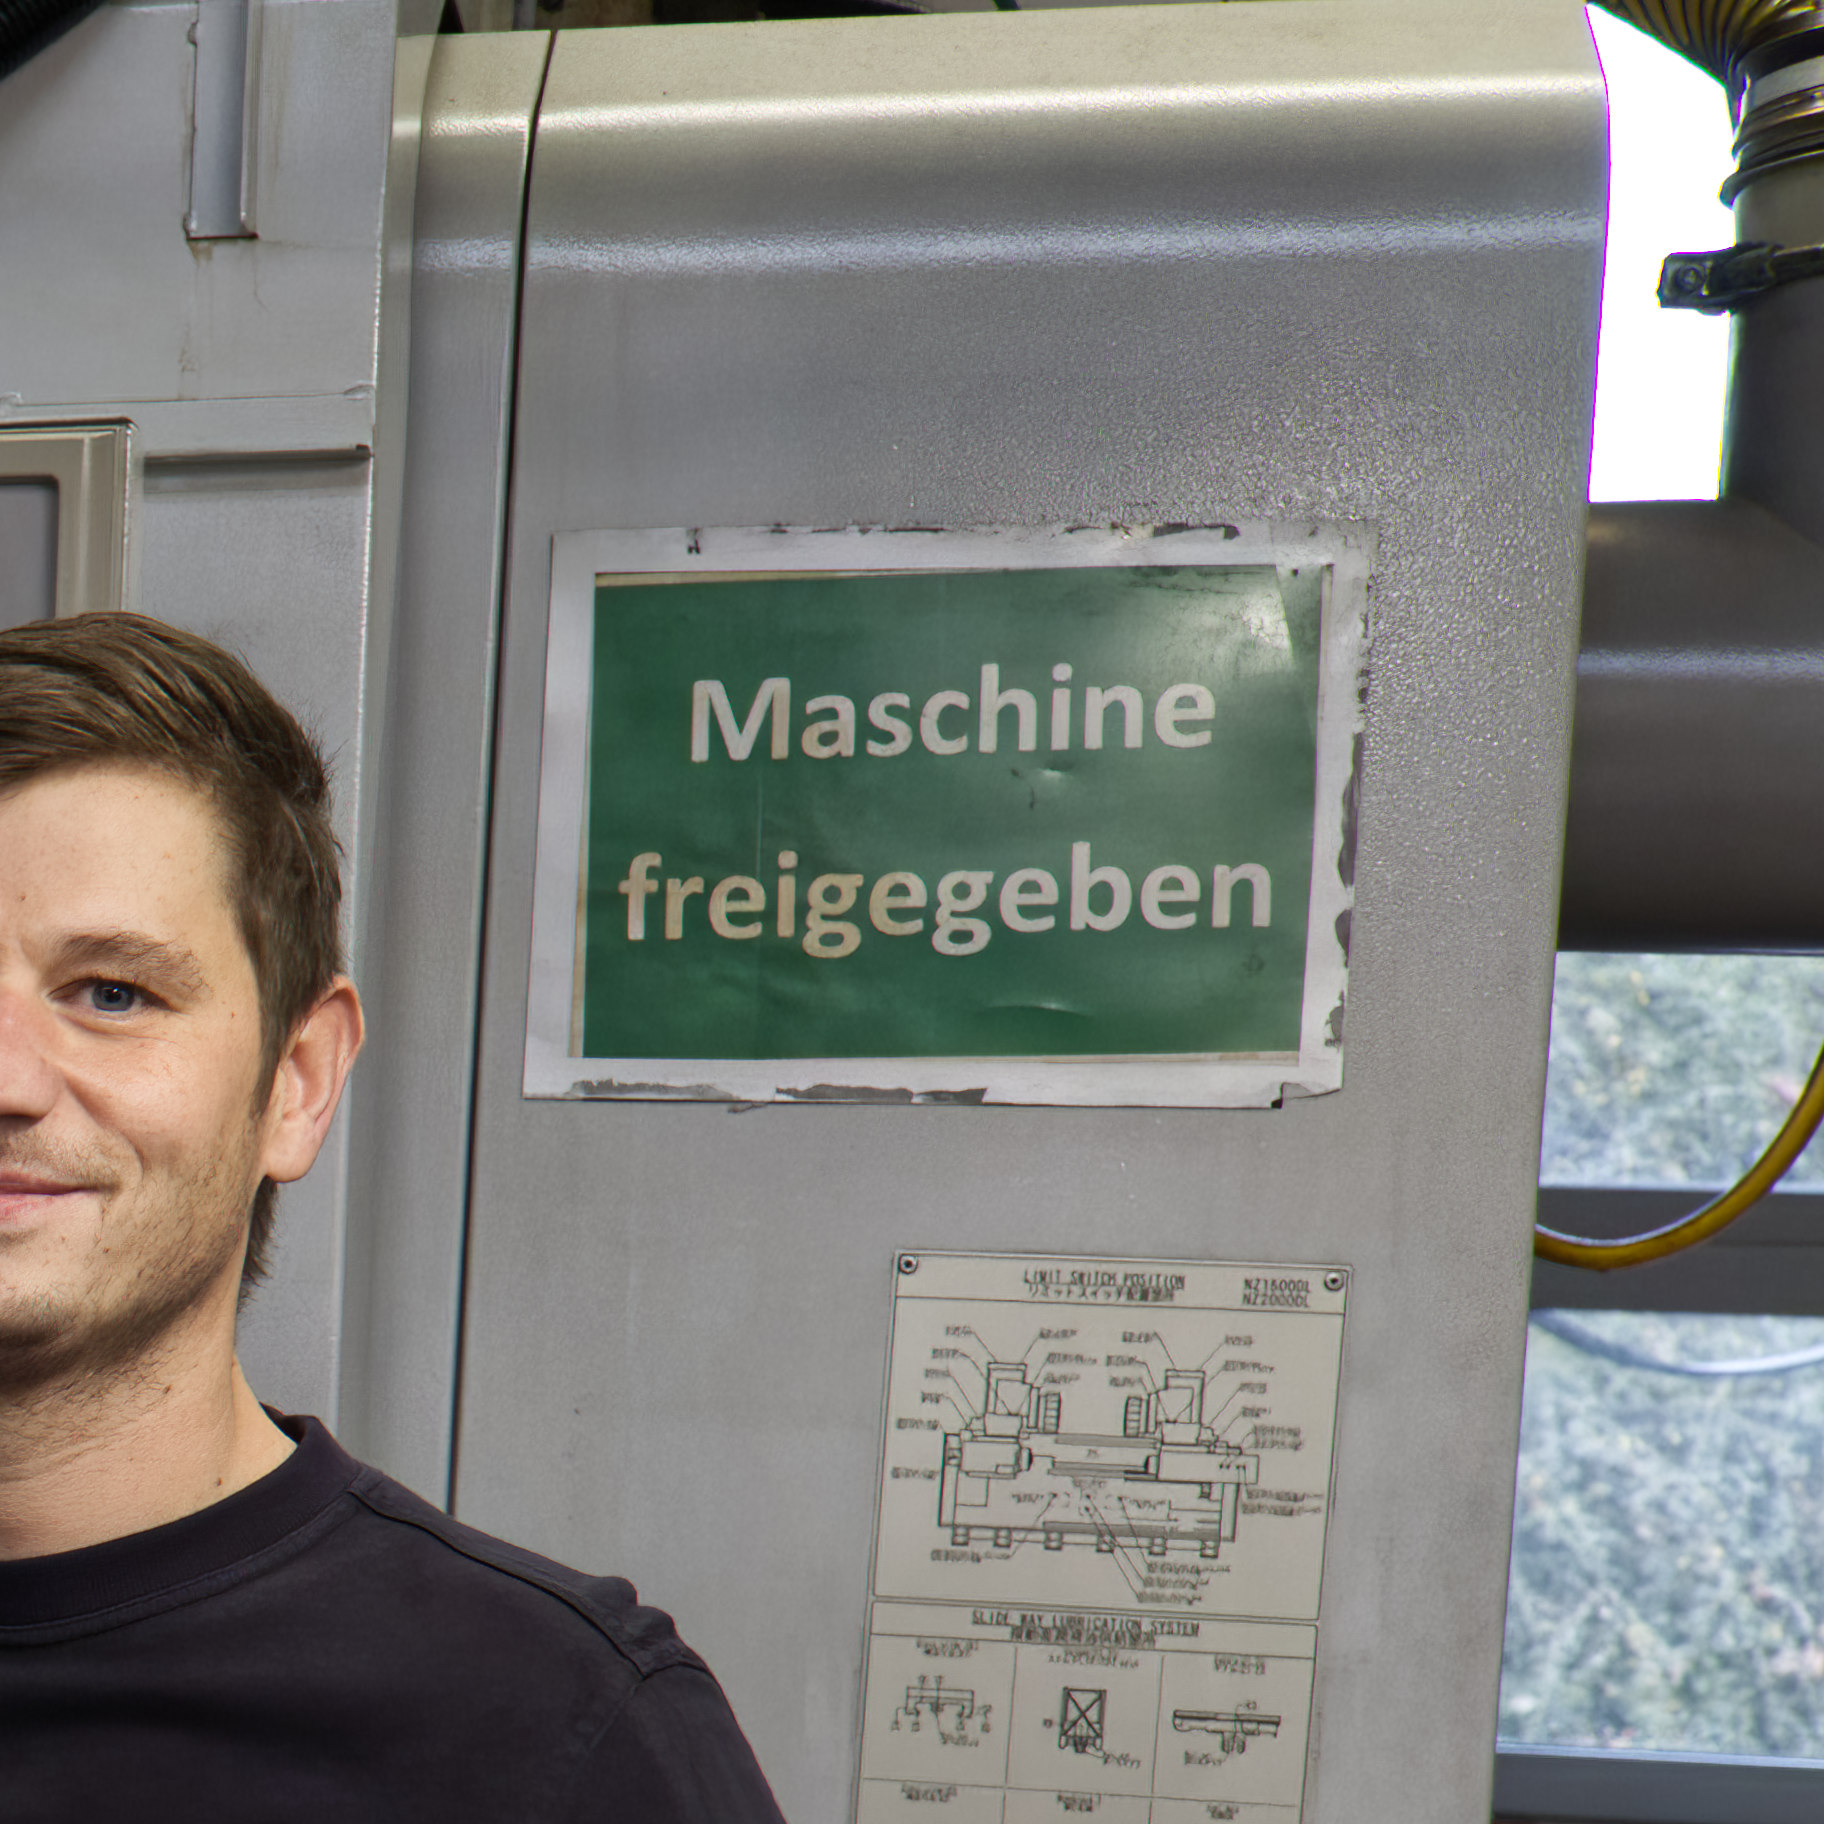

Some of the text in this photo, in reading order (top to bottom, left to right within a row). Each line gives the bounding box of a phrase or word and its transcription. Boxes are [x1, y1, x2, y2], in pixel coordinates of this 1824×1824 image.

[690, 662, 1216, 763] Maschine
[618, 840, 1274, 959] freigegeben
[1023, 1269, 1186, 1291] LIMIT SWITCH POSITION
[972, 1608, 1009, 1626] SLIDE
[1052, 1615, 1142, 1637] LUBRICATION
[1151, 1619, 1200, 1638] SYSTEM
